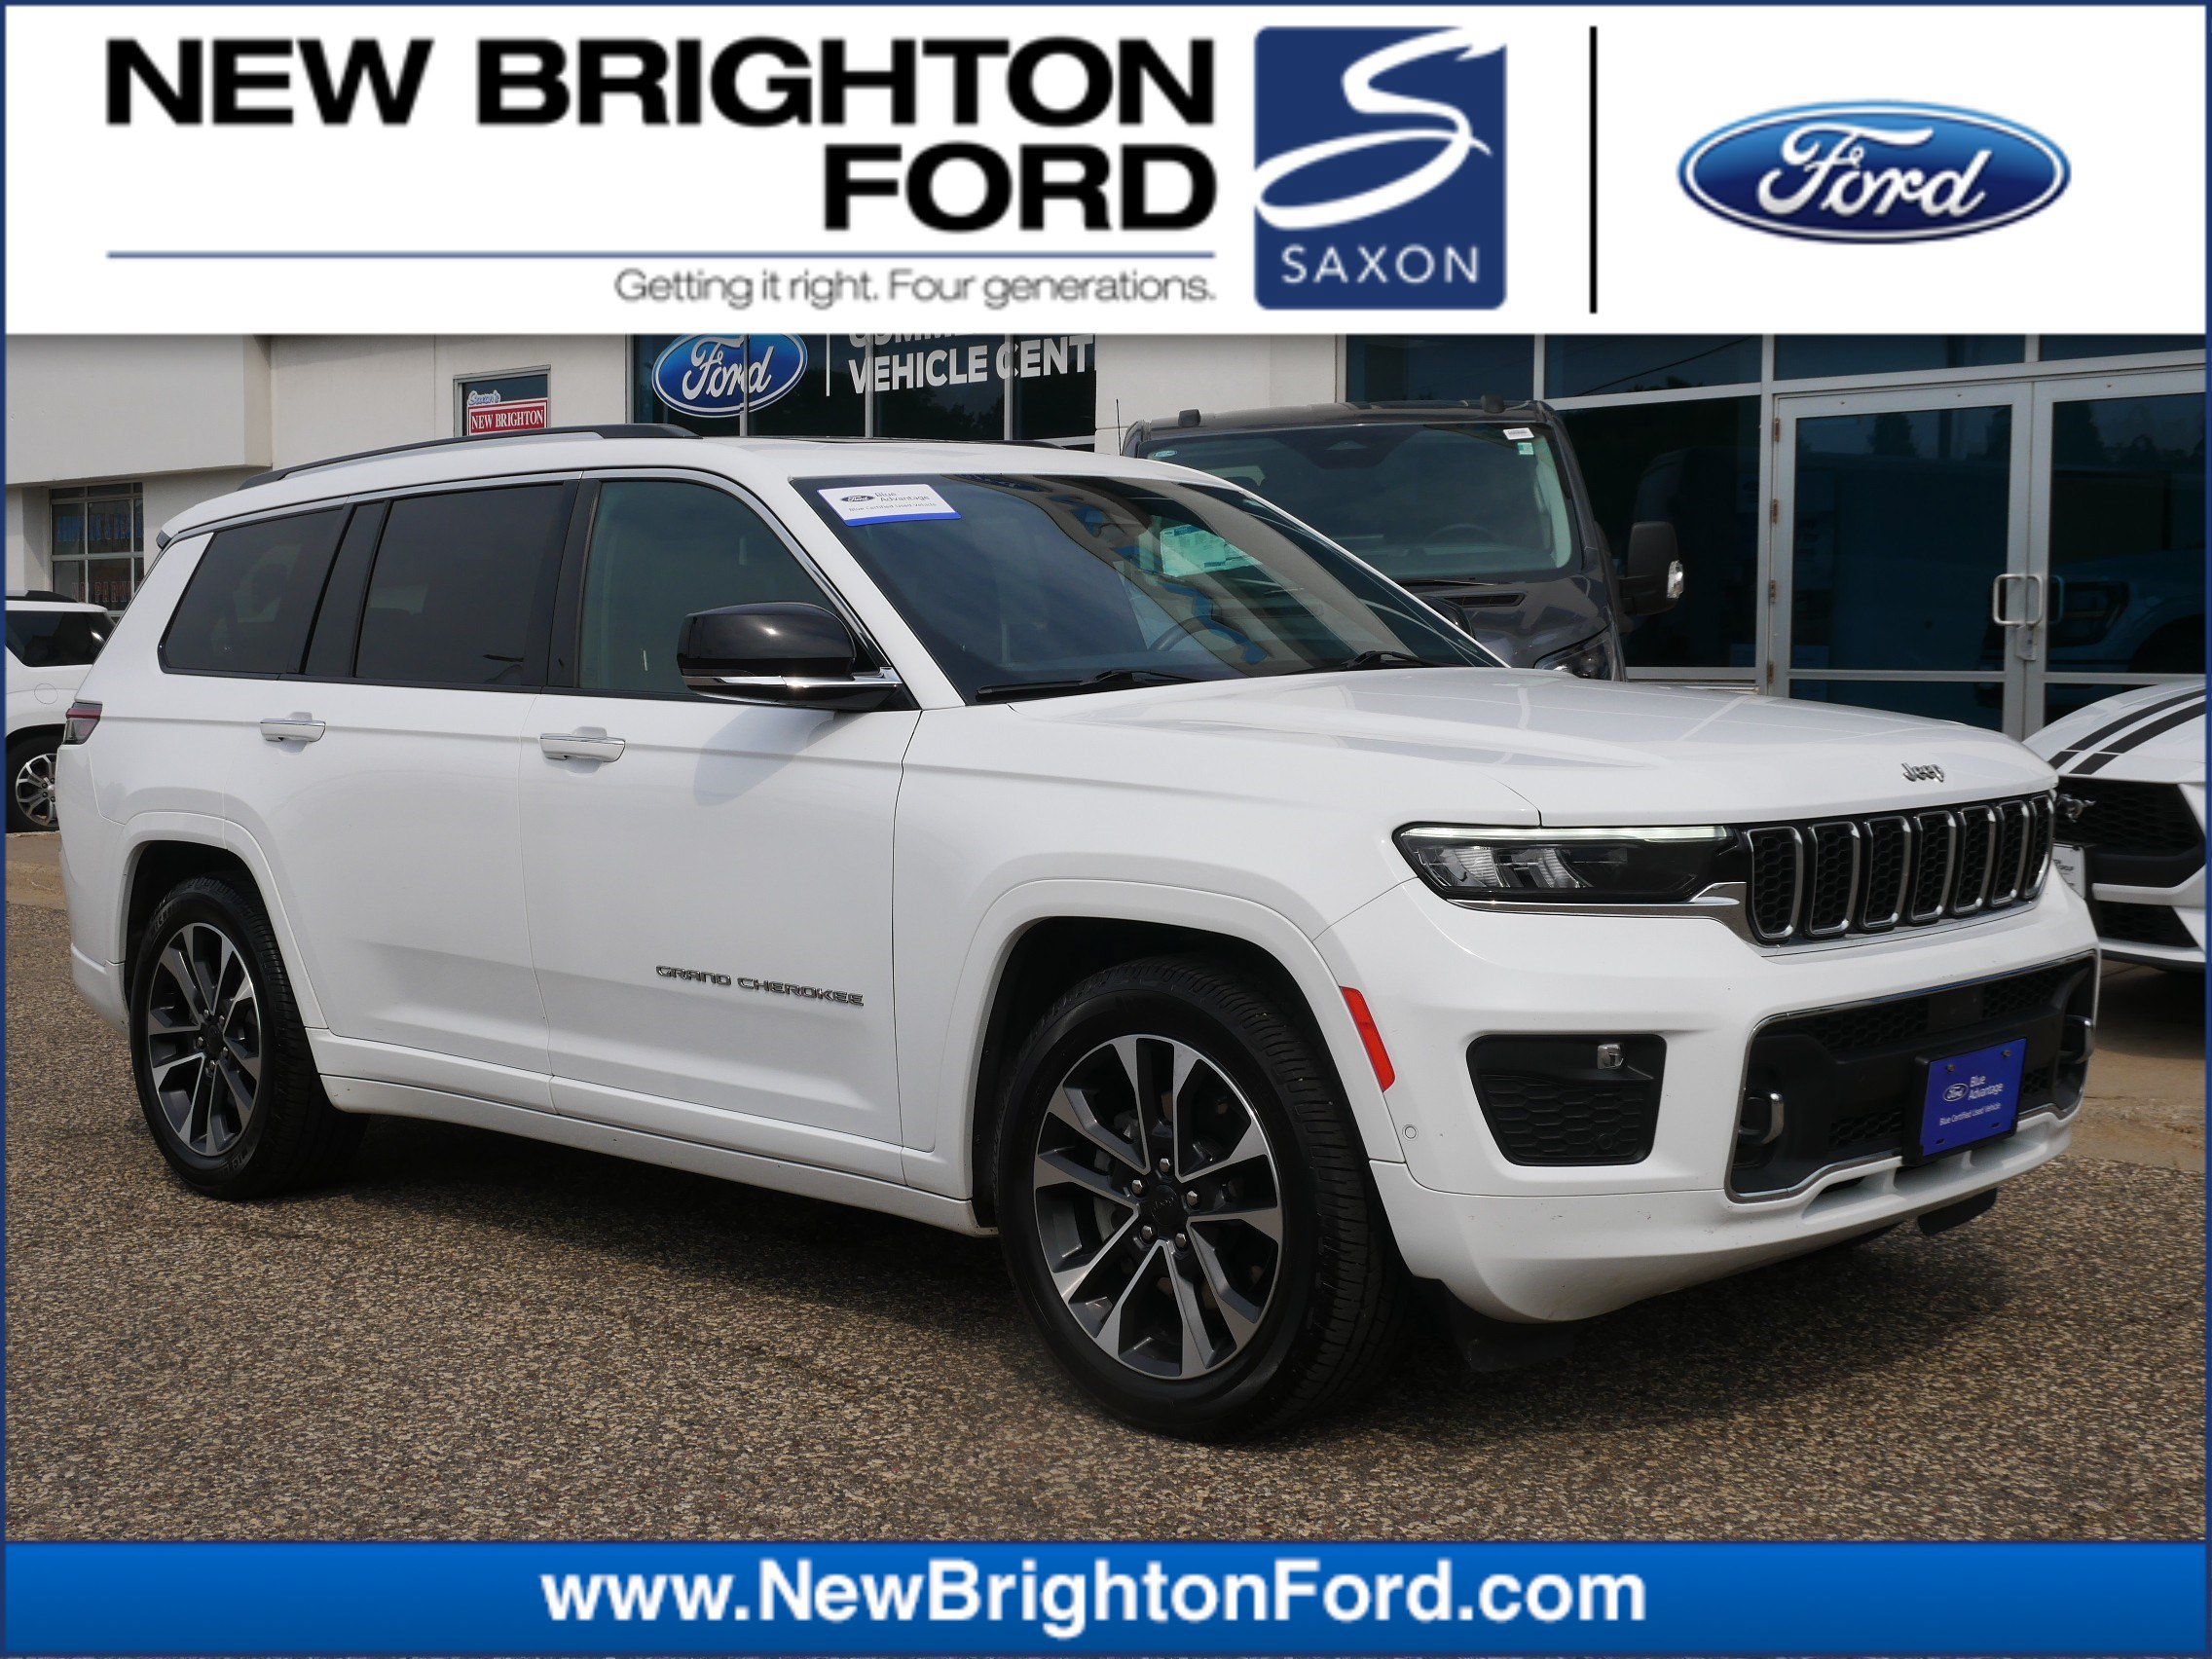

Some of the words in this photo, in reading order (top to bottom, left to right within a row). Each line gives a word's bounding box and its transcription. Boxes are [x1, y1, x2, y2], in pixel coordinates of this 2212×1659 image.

[682, 336, 775, 400] Ford
[848, 345, 989, 394] VEHICLE
[995, 334, 1097, 380] CENT
[471, 414, 494, 429] NEW
[496, 409, 543, 428] BRIGHTON
[1900, 762, 1945, 783] Jeep
[655, 965, 732, 986] GRAND
[737, 977, 865, 1007] CHEROKEE
[1968, 1083, 2004, 1101] Advantage
[1970, 1075, 1986, 1088] Blue
